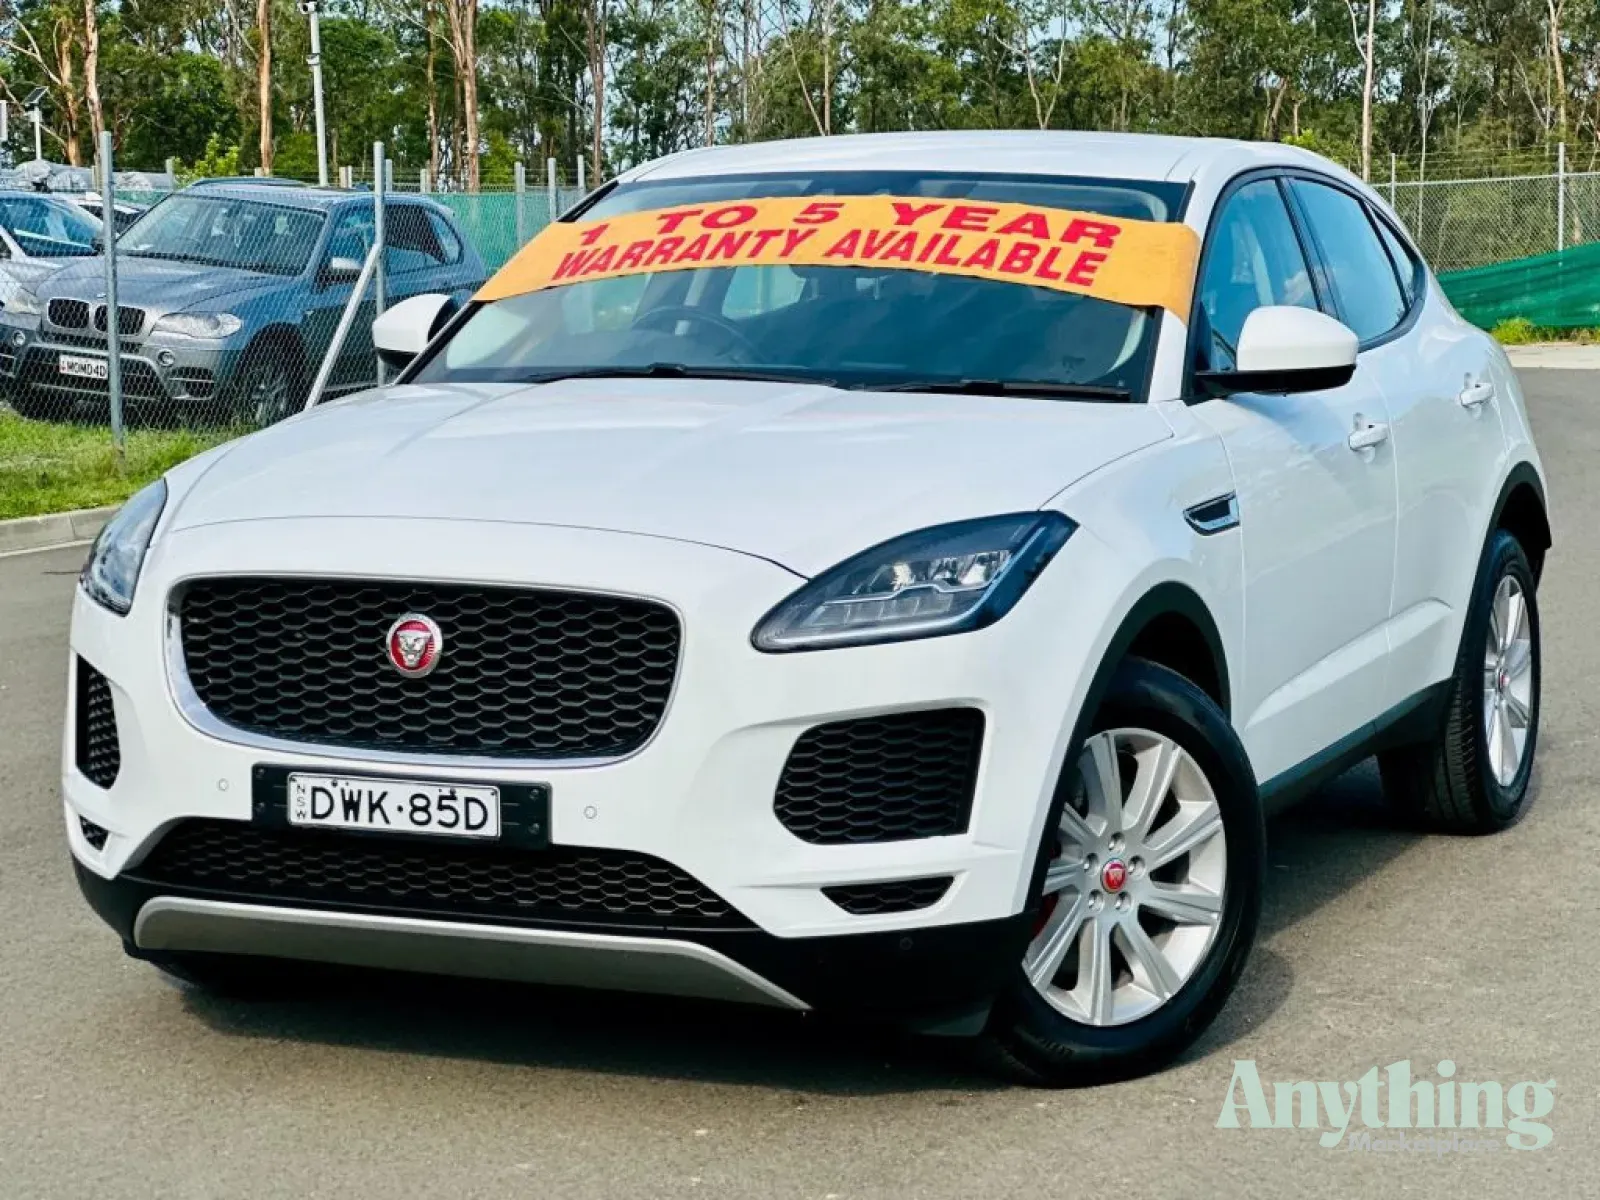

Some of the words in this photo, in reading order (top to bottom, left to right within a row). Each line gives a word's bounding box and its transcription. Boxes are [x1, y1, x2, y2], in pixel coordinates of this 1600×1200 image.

[580, 224, 609, 246] 1
[656, 205, 758, 235] TO
[792, 202, 845, 225] 5
[890, 202, 1122, 249] YEAR
[551, 228, 818, 281] WARRANTY
[822, 229, 1108, 287] AVAILABLE
